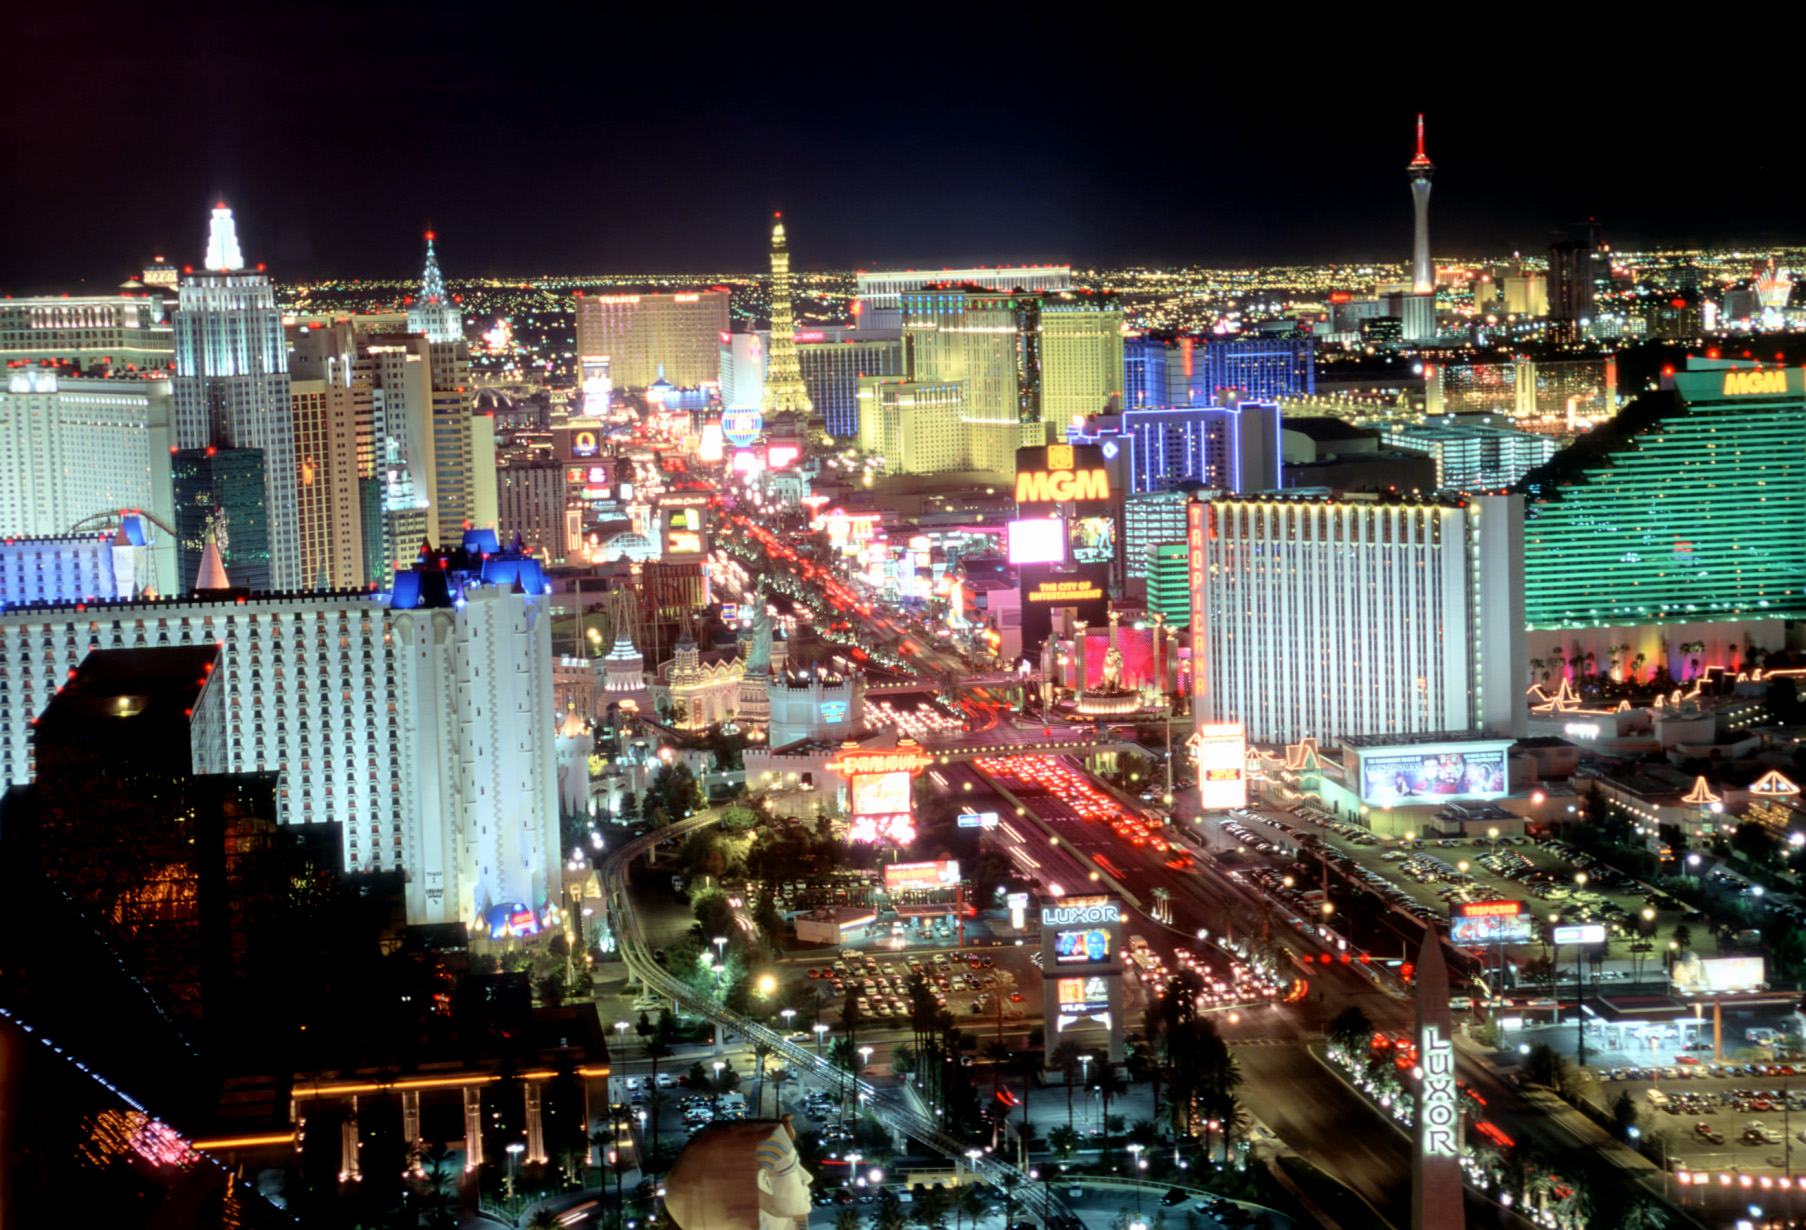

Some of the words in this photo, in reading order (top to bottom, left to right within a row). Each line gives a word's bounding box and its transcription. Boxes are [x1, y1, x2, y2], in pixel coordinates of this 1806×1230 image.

[1724, 371, 1787, 395] MGM
[1016, 469, 1109, 502] MGM
[1073, 547, 1115, 560] EFX
[1029, 589, 1103, 601] ENTERTAINMENT
[1039, 583, 1058, 592] THE
[1058, 582, 1078, 591] CITY
[1078, 581, 1092, 590] OF
[1190, 506, 1208, 697] TROPICANA
[844, 755, 916, 774] EXCALIBUR
[1042, 906, 1120, 925] LUXOR
[1465, 903, 1518, 916] TROPICANA
[1426, 1027, 1457, 1154] LUXOR
